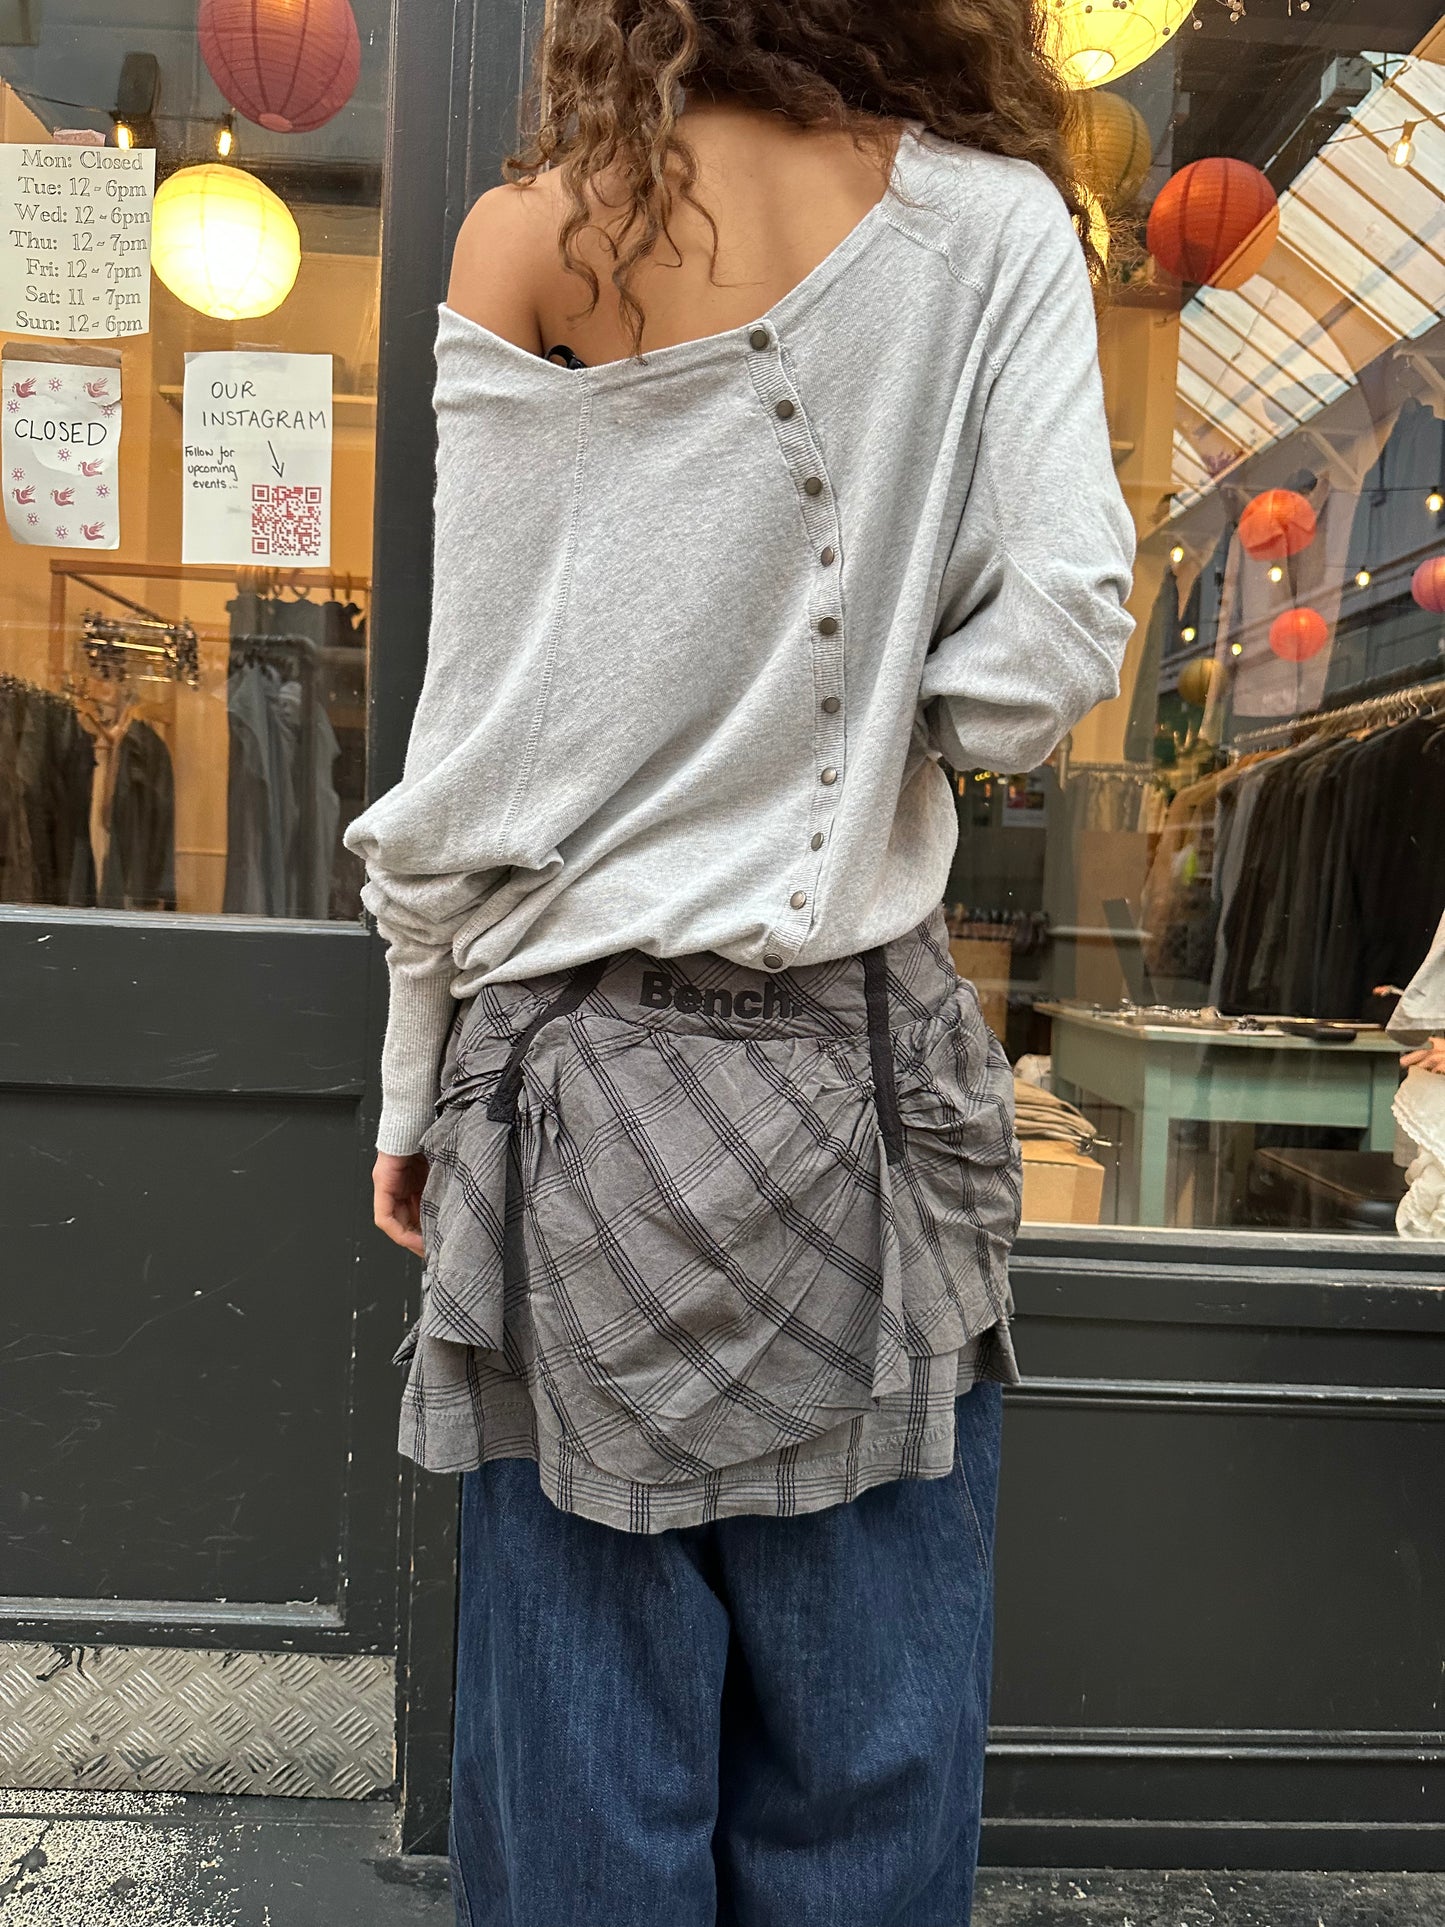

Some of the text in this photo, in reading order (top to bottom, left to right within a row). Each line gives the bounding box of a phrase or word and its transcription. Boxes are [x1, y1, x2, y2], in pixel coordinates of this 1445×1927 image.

[21, 149, 143, 170] Mon: Closed
[17, 176, 62, 195] Tue:
[69, 177, 91, 197] 12
[105, 179, 147, 202] 6pm
[14, 203, 68, 223] Wed:
[74, 206, 95, 224] 12
[110, 207, 151, 229] 6pm
[9, 230, 58, 250] Thu:
[72, 232, 93, 251] 12
[109, 233, 147, 256] 7pm
[26, 258, 59, 277] Fri:
[67, 259, 88, 278] 12
[104, 262, 142, 283] 7pm
[25, 285, 61, 304] Sat:
[68, 288, 85, 305] 11
[105, 288, 141, 310] 7pm
[16, 310, 60, 331] Sun:
[68, 314, 90, 332] 12
[105, 315, 143, 336] 6pm
[211, 380, 256, 399] OUR
[14, 418, 107, 446] CLOSED
[202, 409, 326, 430] INSTAGRAM
[184, 445, 236, 465] Follow for
[187, 464, 239, 481] upcoming
